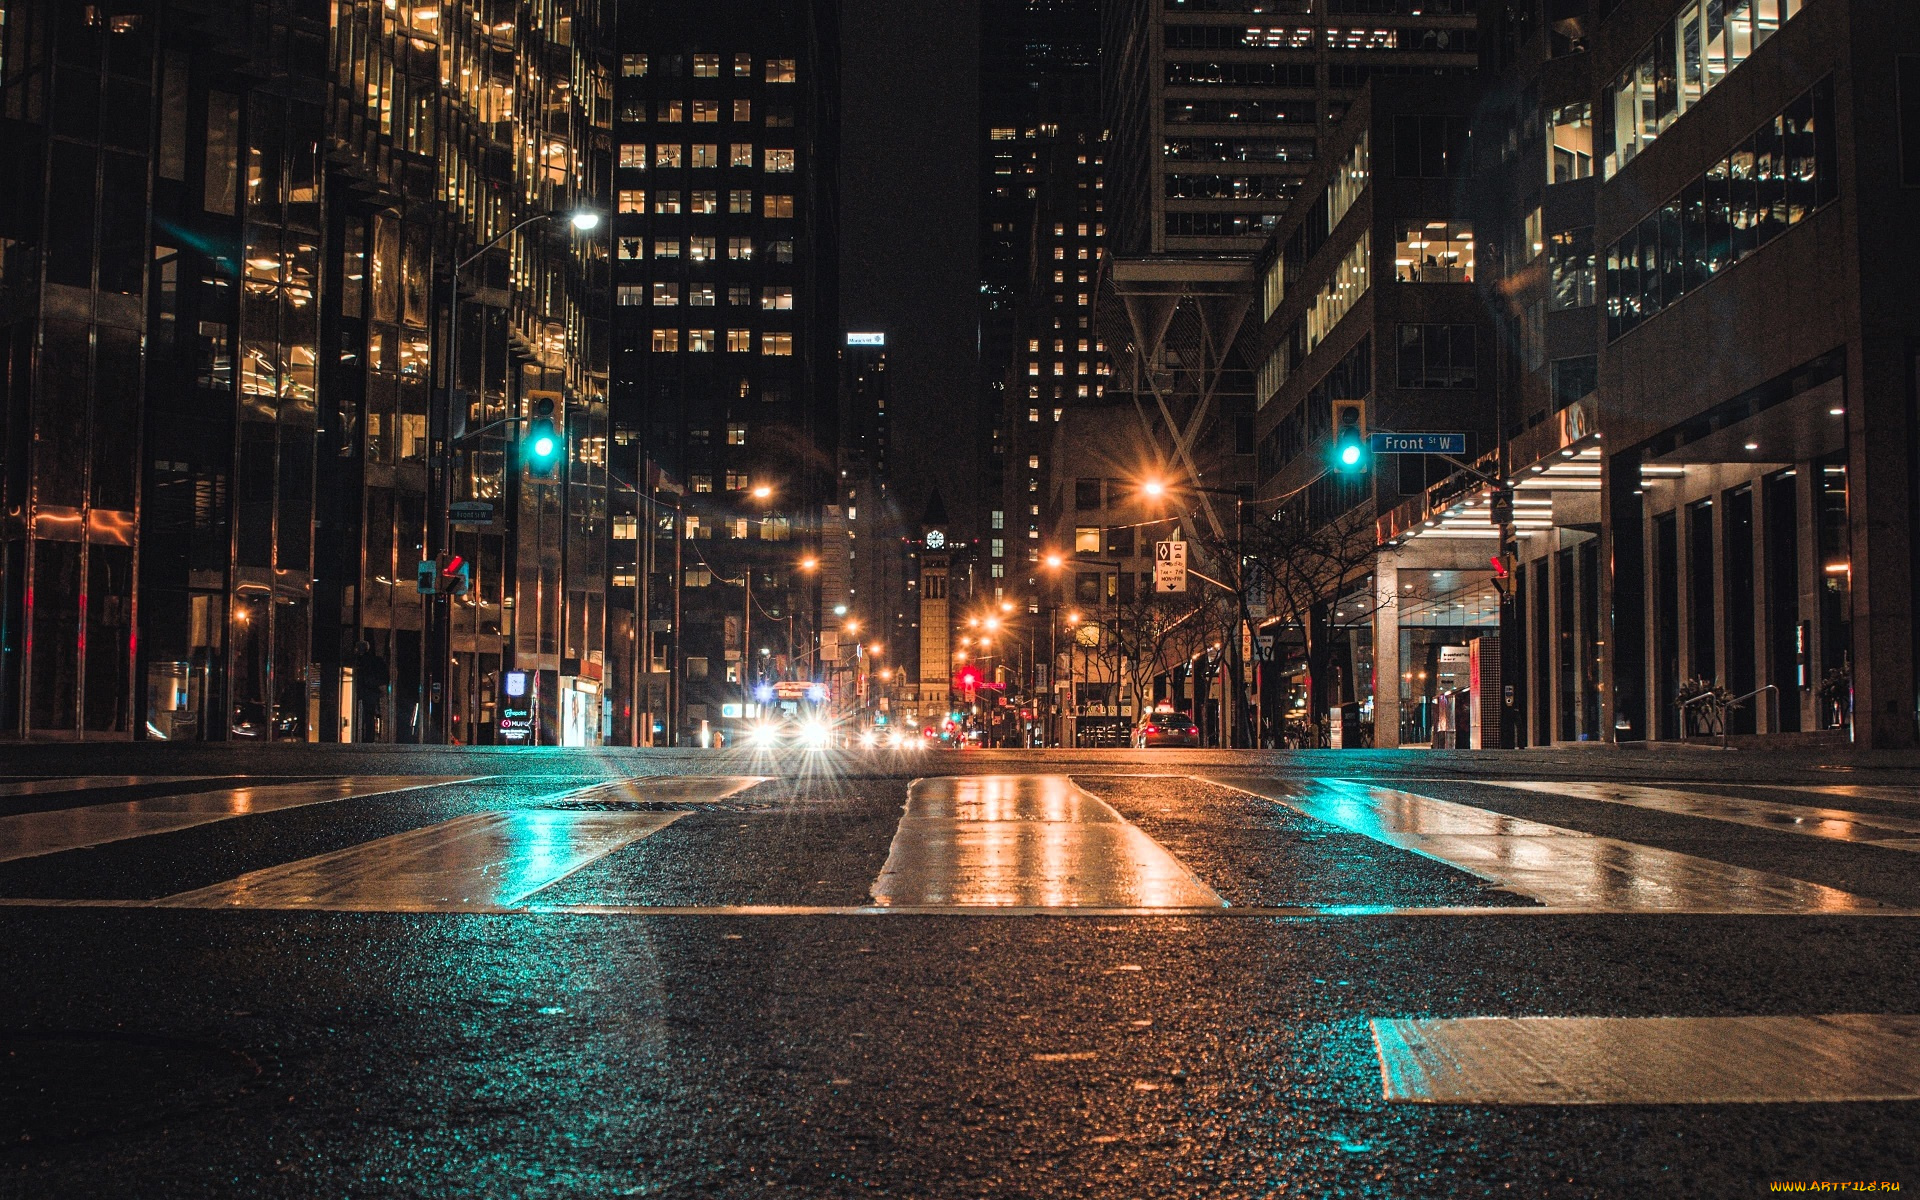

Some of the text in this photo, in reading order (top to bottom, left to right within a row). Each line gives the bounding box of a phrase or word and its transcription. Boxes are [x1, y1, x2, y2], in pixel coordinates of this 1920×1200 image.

[1385, 436, 1451, 449] Front St W
[456, 511, 474, 519] Front
